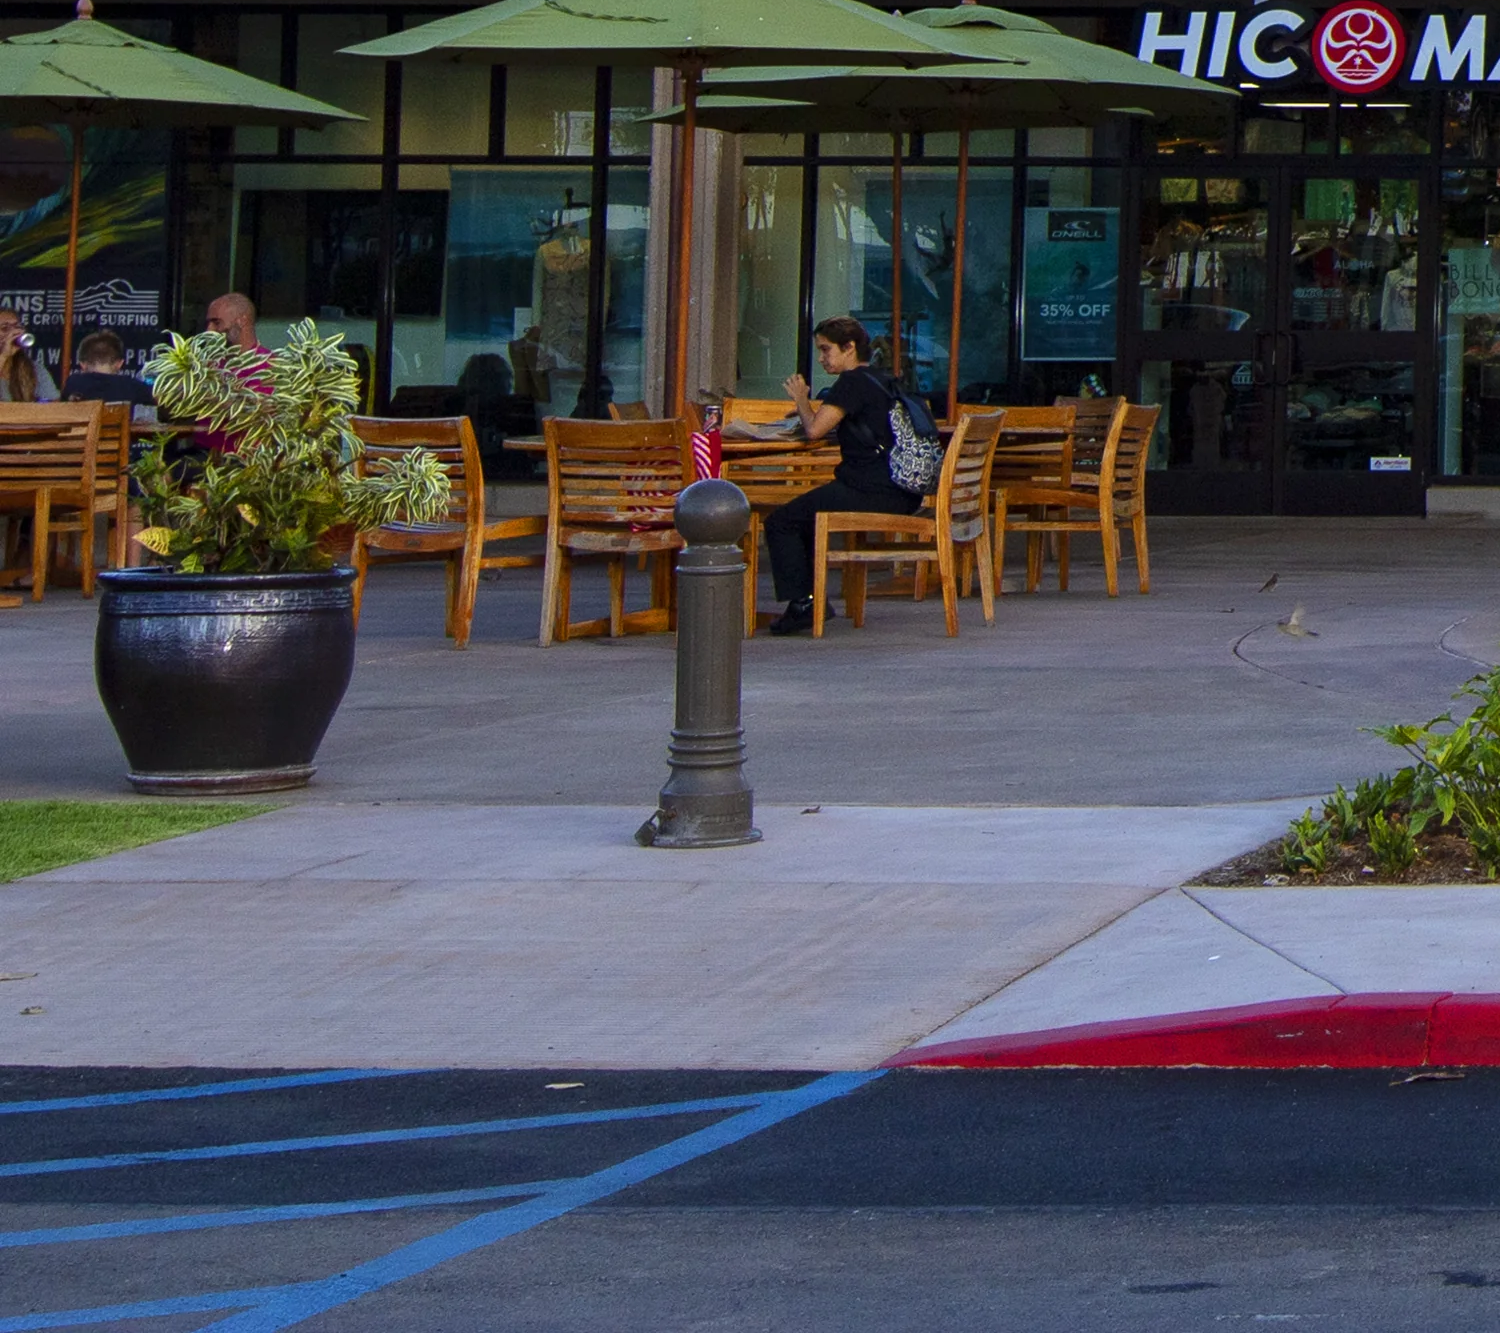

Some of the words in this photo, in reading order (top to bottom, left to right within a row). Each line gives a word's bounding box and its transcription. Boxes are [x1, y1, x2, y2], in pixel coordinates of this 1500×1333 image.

[1136, 9, 1306, 80] HIC
[0, 295, 44, 312] ANS
[1040, 303, 1075, 317] 35%
[1078, 303, 1112, 317] OFF
[99, 313, 158, 326] SURFING
